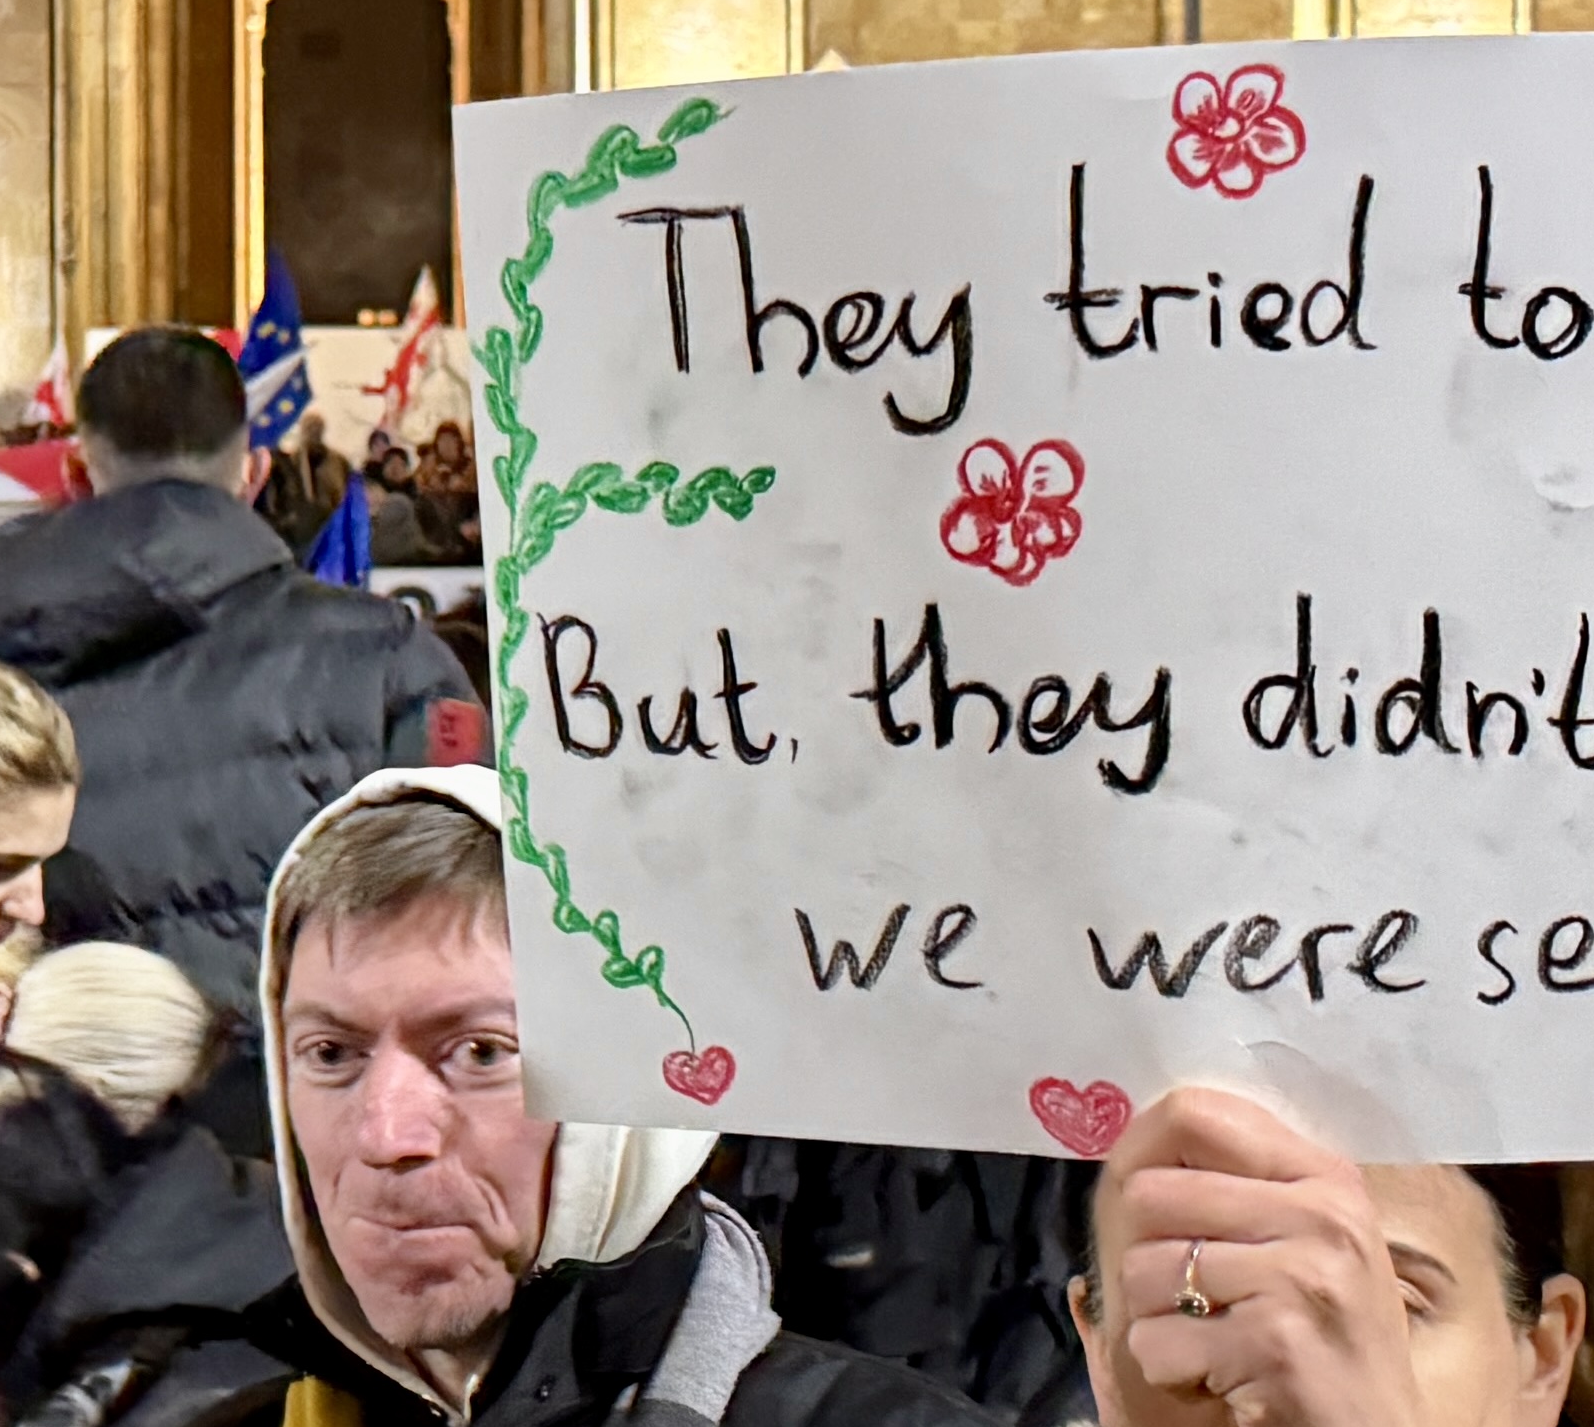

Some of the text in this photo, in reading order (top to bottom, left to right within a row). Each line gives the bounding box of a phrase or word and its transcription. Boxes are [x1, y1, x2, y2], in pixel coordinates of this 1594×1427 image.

[617, 204, 974, 437] They
[1043, 161, 1379, 360] tried
[1458, 164, 1594, 362] to
[849, 602, 1173, 796] they
[794, 903, 984, 992] we
[1086, 909, 1427, 1007] were
